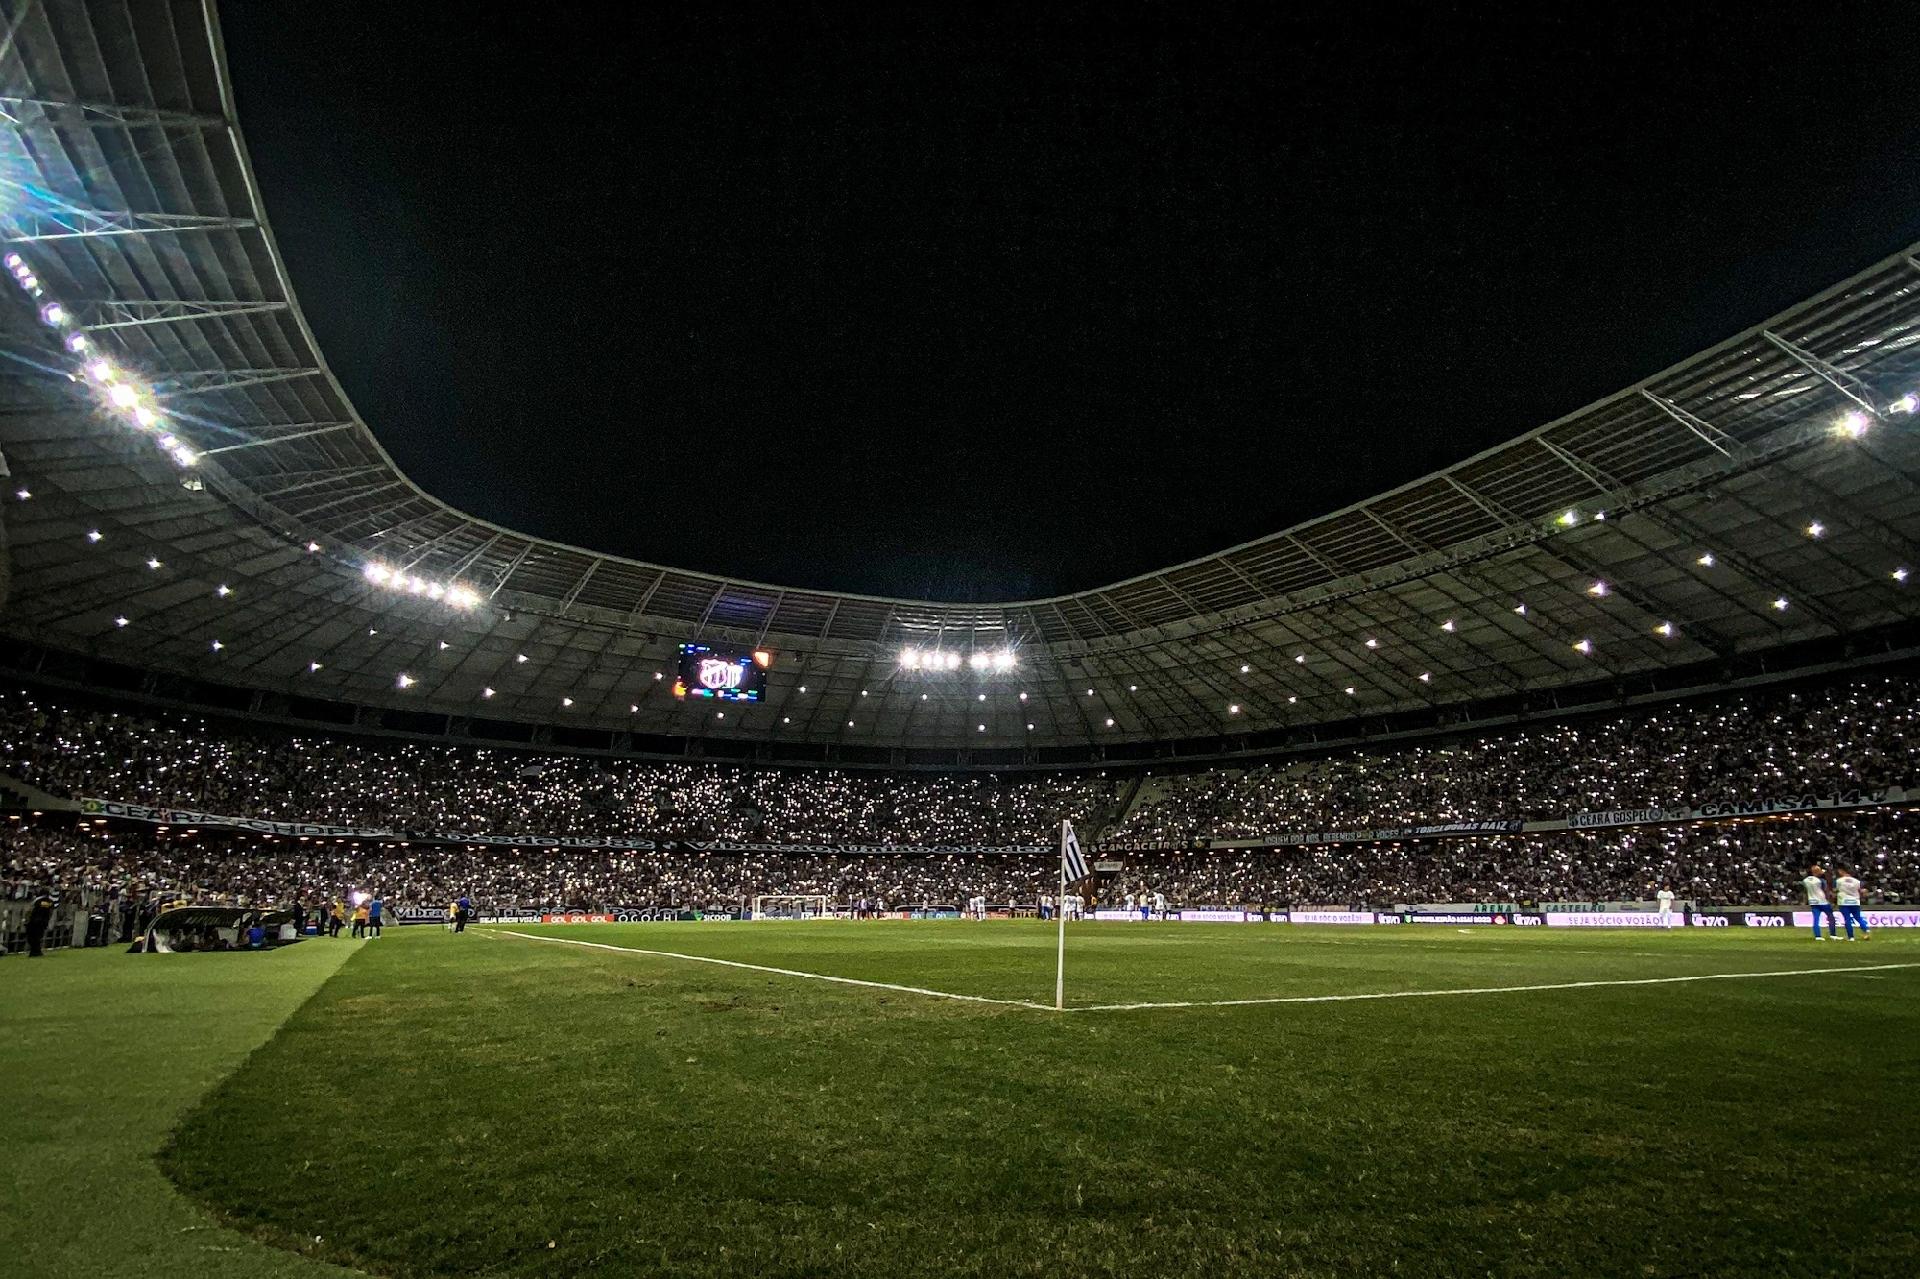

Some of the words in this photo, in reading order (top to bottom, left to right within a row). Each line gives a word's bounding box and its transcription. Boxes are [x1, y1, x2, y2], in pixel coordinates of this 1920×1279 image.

[1700, 793, 1819, 816] CAMISA
[1827, 788, 1862, 806] 14
[1613, 809, 1648, 824] GOSPEL
[1098, 840, 1190, 852] CANGACEIRS
[1473, 904, 1513, 913] ARENA
[551, 915, 566, 923] GOL
[571, 915, 588, 923] GOL
[591, 915, 608, 923] GOL
[617, 914, 678, 922] OGOCHI
[703, 914, 732, 922] SICOOB
[1869, 914, 1905, 926] ÓCIO
